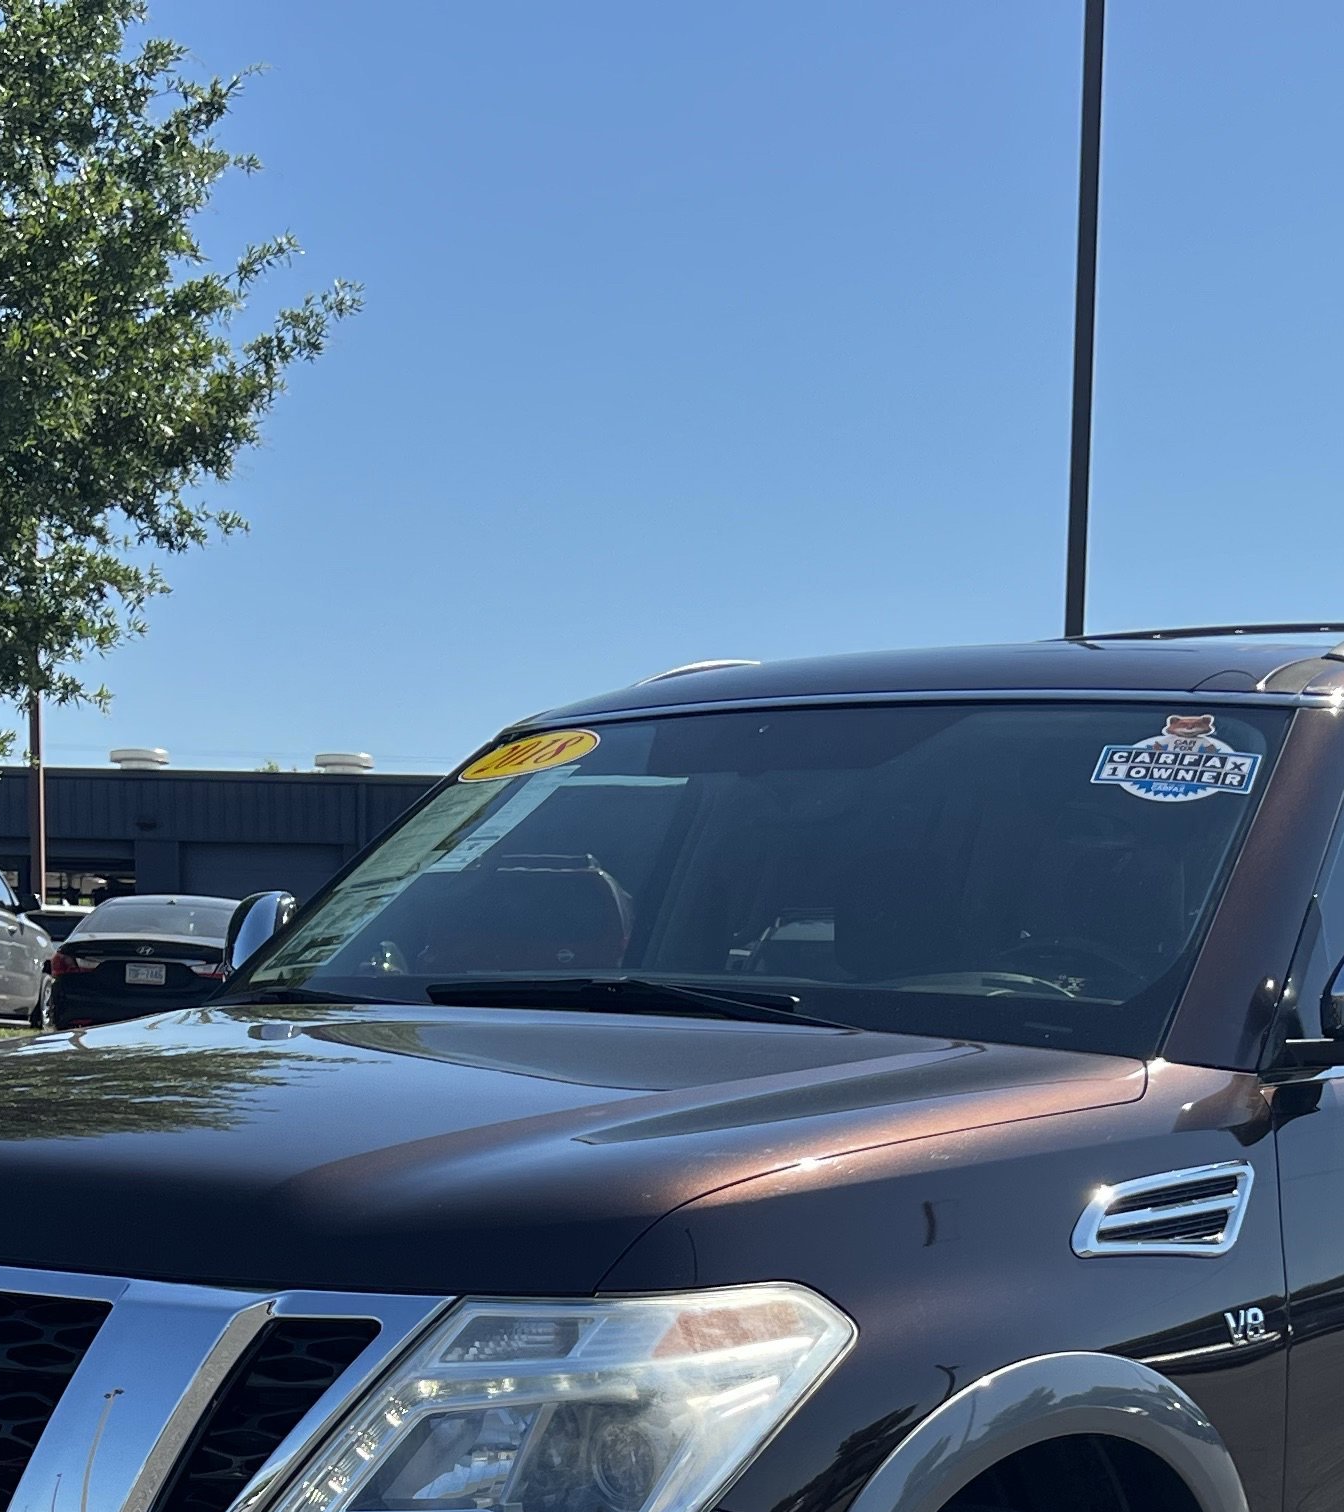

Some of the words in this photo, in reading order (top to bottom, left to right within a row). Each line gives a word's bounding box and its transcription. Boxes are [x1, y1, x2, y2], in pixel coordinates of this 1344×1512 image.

[471, 735, 585, 775] 2018
[1112, 751, 1247, 772] CARFAX
[1107, 766, 1119, 778] 1
[1129, 767, 1245, 786] OWNER
[1224, 1307, 1266, 1346] V8
